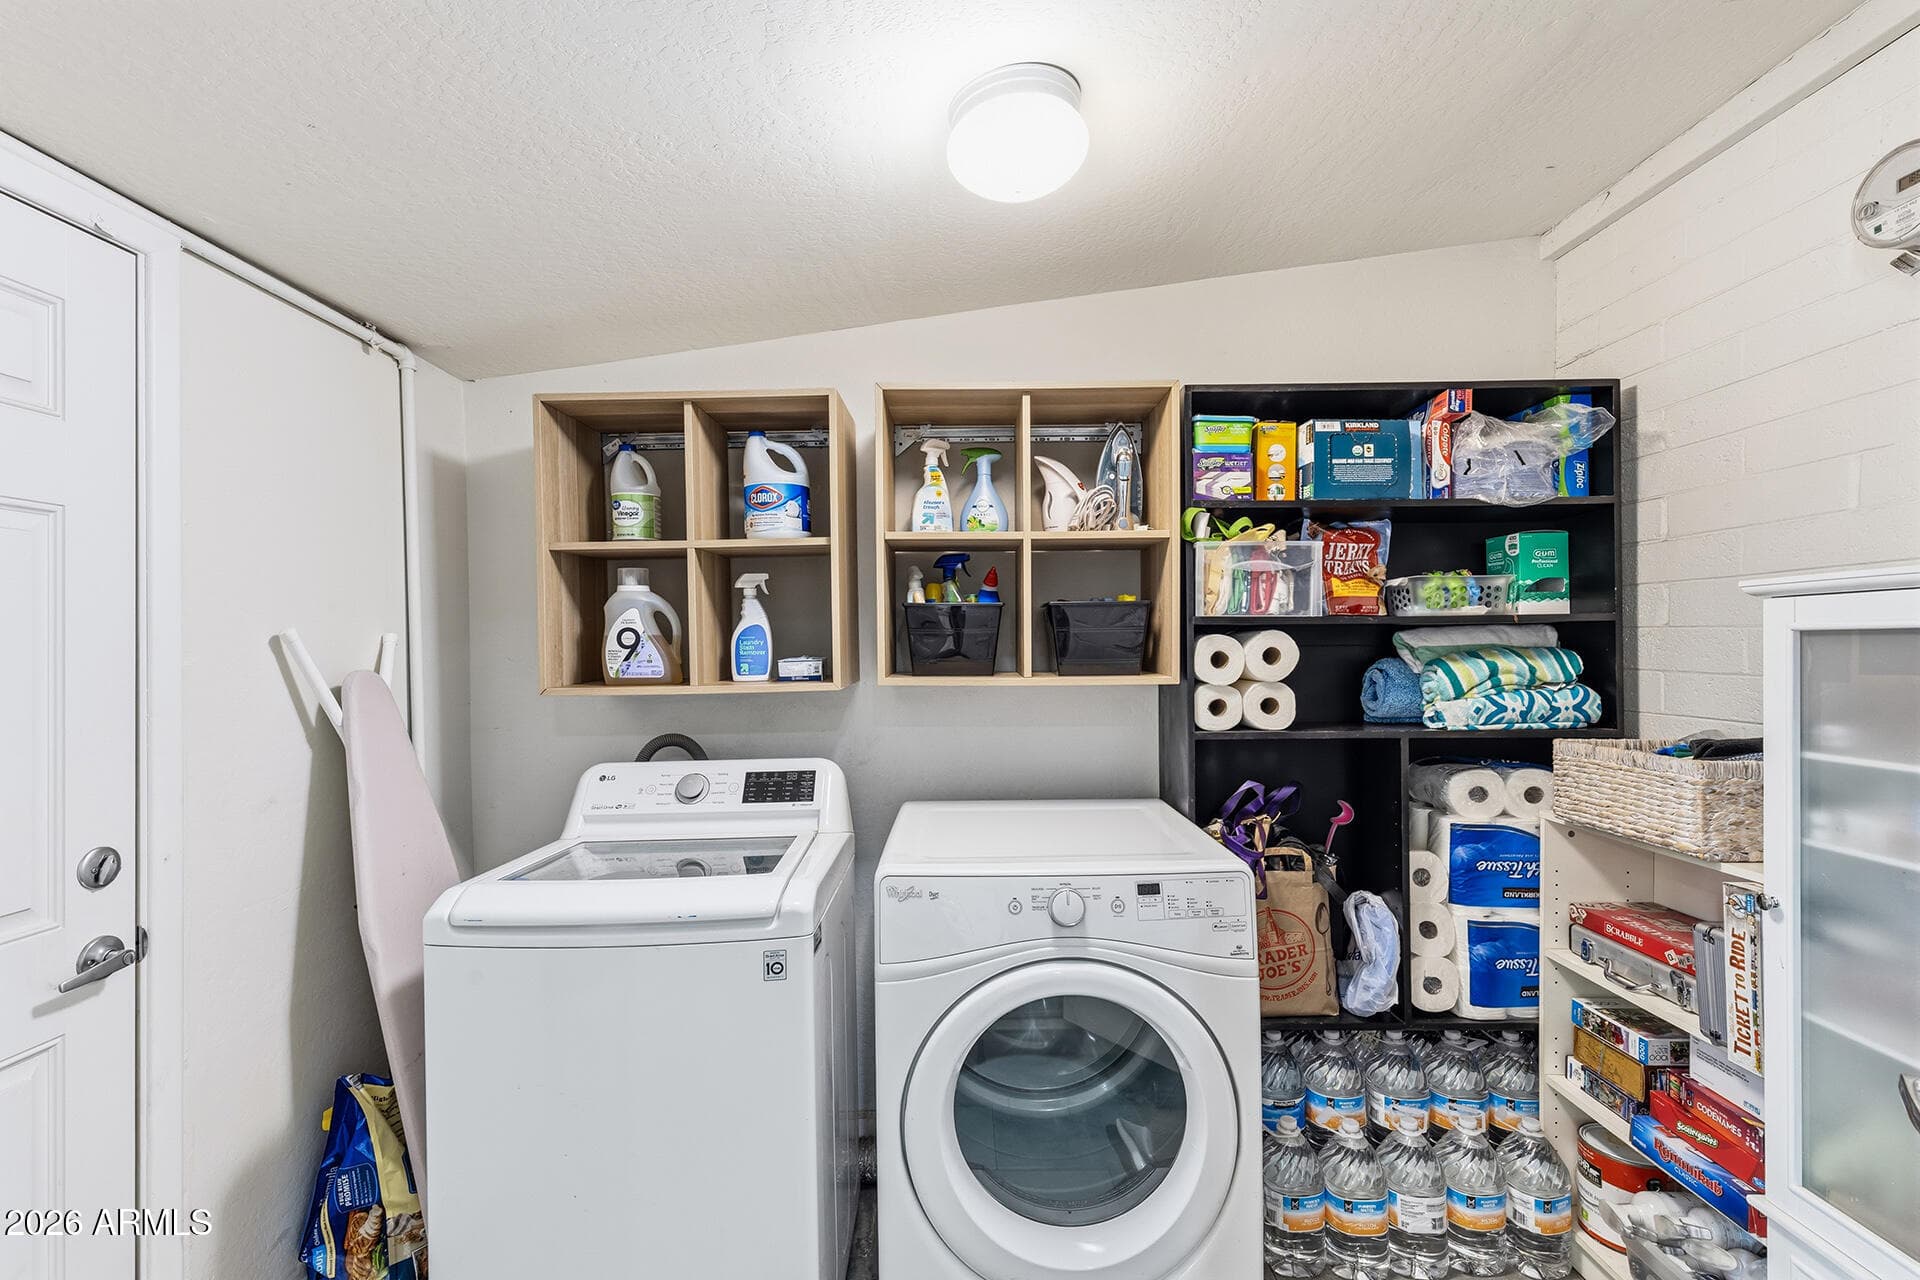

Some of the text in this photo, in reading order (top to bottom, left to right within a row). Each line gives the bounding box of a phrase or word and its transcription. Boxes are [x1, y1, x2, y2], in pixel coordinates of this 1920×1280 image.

[1441, 422, 1450, 457] Colgate
[1573, 461, 1585, 489] Ziploc
[751, 493, 778, 503] CLOROX
[1325, 542, 1375, 560] JERKY
[1324, 560, 1370, 576] TREATS
[616, 627, 641, 662] 9
[1476, 860, 1523, 878] Tissue
[1605, 923, 1644, 948] SCRABBLE
[1495, 958, 1539, 977] Tissue
[1730, 927, 1752, 1057] TICKET TO RIDE
[1696, 1101, 1743, 1139] CODENAMES
[1654, 1136, 1724, 1196] Rummikub
[1674, 1166, 1698, 1187] CLASSIC
[341, 1174, 352, 1207] PROMISE
